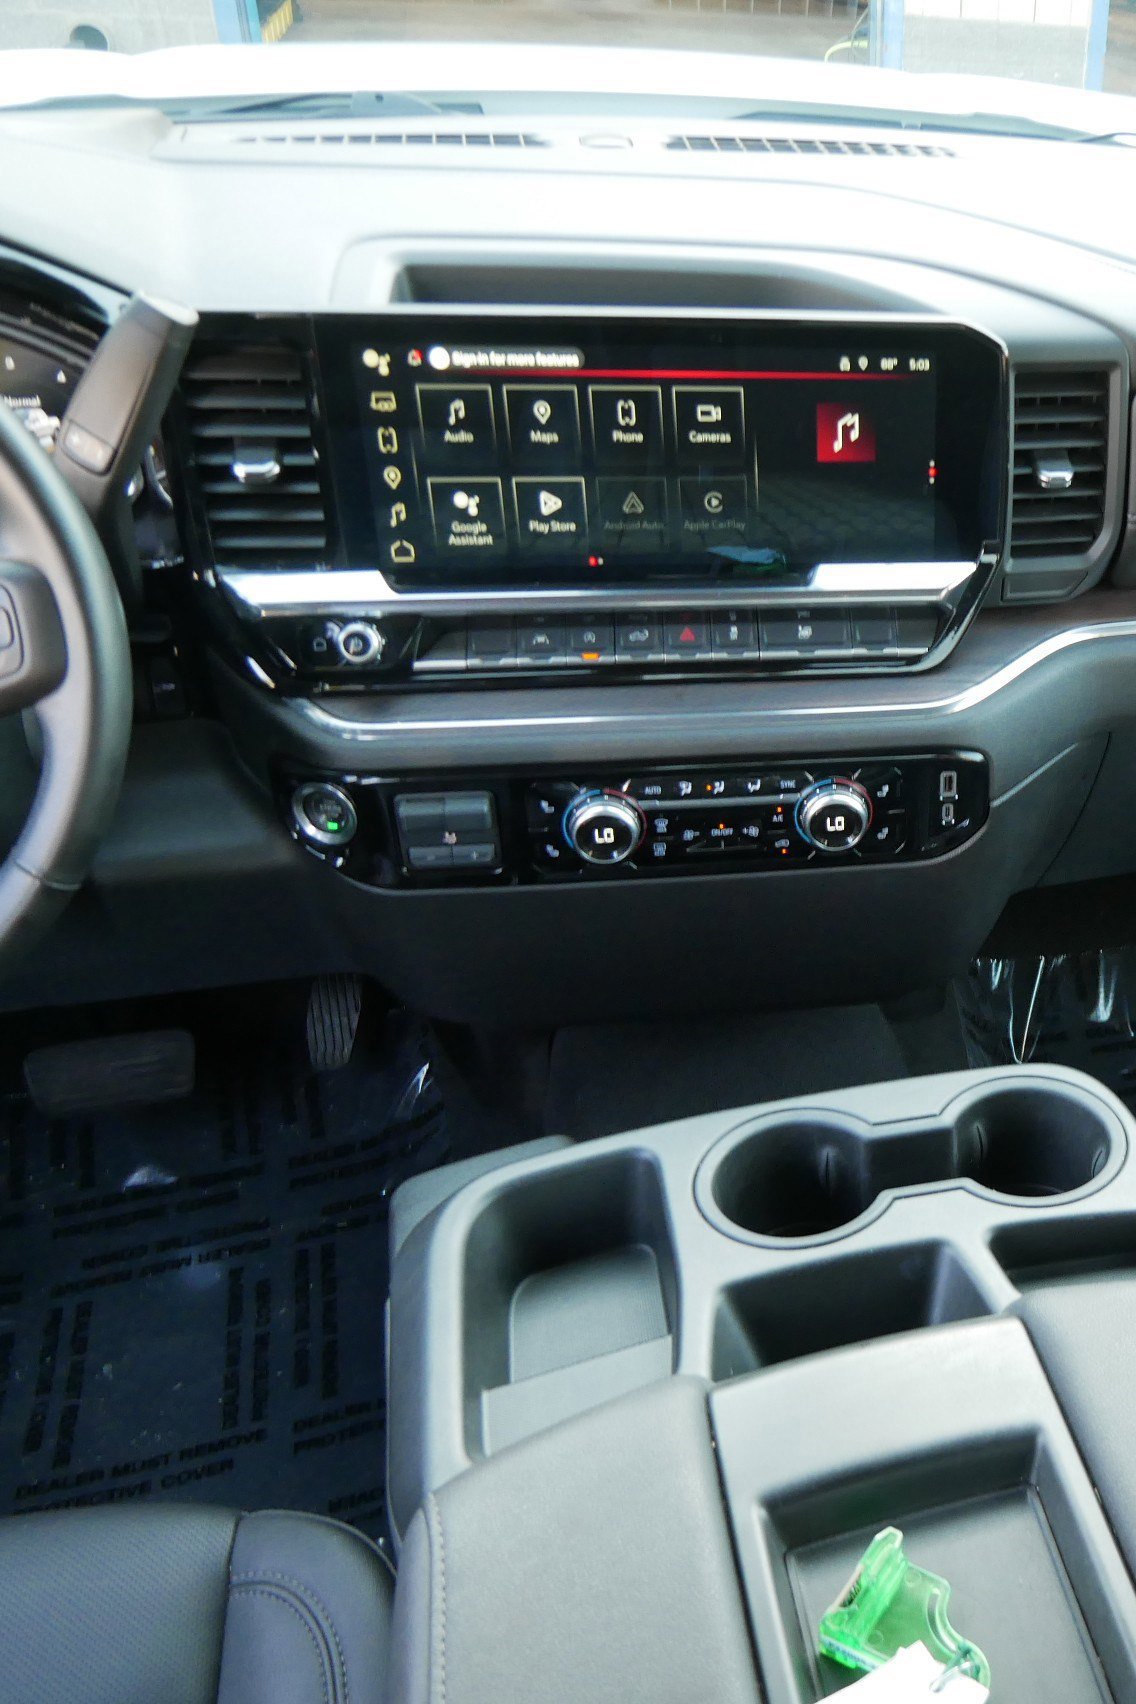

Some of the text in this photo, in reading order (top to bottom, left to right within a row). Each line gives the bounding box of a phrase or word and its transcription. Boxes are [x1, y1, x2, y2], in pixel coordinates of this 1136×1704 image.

[443, 430, 474, 443] Audio
[530, 430, 559, 444] Maps
[612, 430, 644, 443] Phone
[688, 430, 732, 444] Cameras
[451, 521, 488, 536] Google
[528, 519, 577, 535] Play Store
[449, 533, 493, 546] Assistant
[644, 785, 662, 796] AUTO
[826, 815, 845, 833] LO
[594, 827, 615, 845] LO
